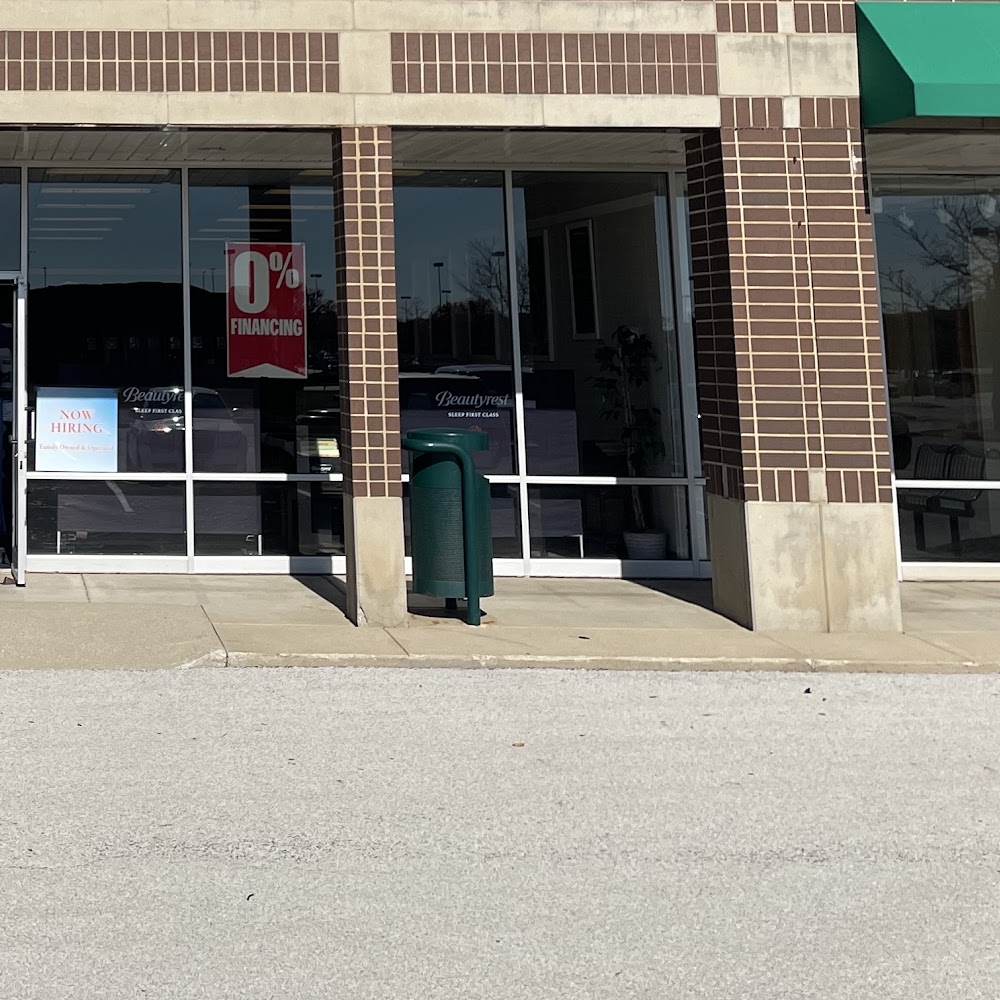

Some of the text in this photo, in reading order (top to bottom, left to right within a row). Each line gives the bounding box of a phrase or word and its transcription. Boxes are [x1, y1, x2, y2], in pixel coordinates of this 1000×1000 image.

[234, 250, 300, 314] 0%
[230, 318, 303, 336] FINANCING
[435, 390, 510, 409] Beautyrest
[60, 409, 92, 420] NOW
[51, 422, 103, 434] HIRING
